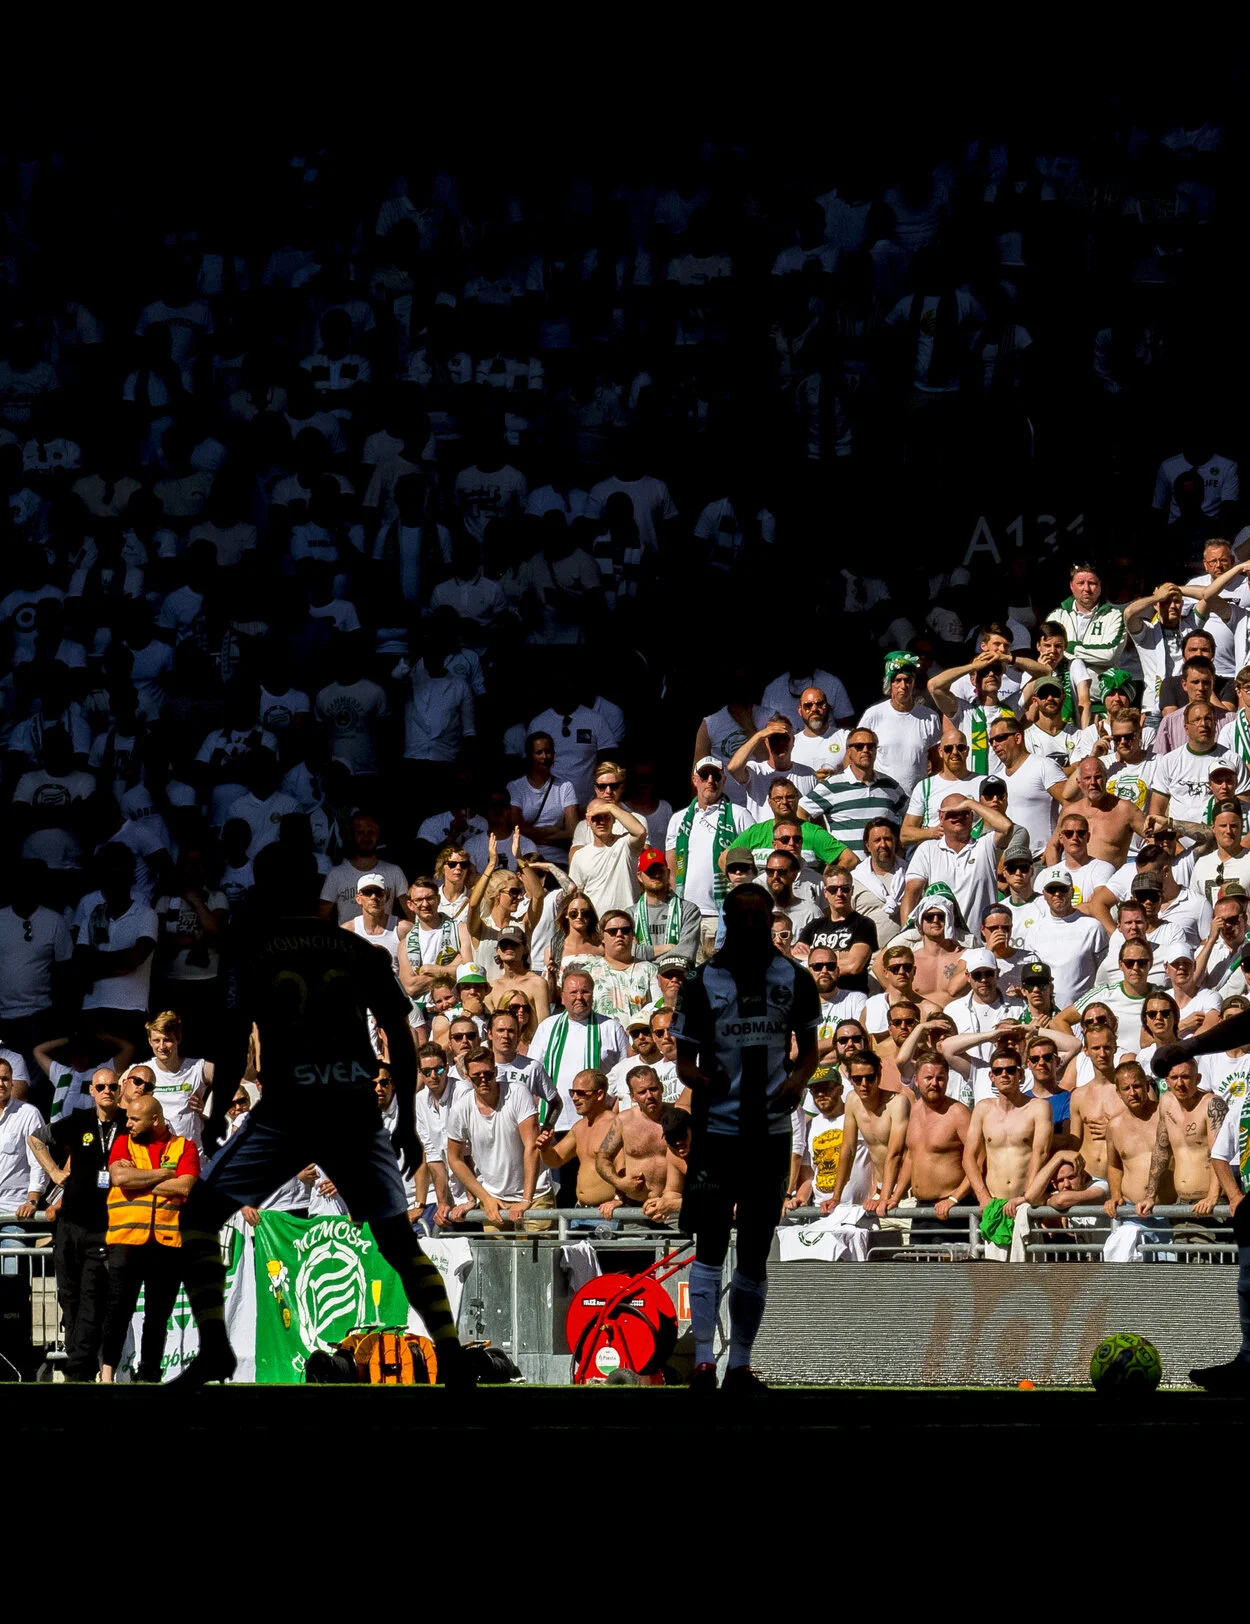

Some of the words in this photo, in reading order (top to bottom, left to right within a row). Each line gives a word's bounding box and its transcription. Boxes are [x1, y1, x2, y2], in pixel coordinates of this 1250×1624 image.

[1090, 621, 1104, 636] H
[811, 932, 852, 949] 1897
[294, 1062, 372, 1085] SVEA
[293, 1218, 373, 1261] MIMOSA
